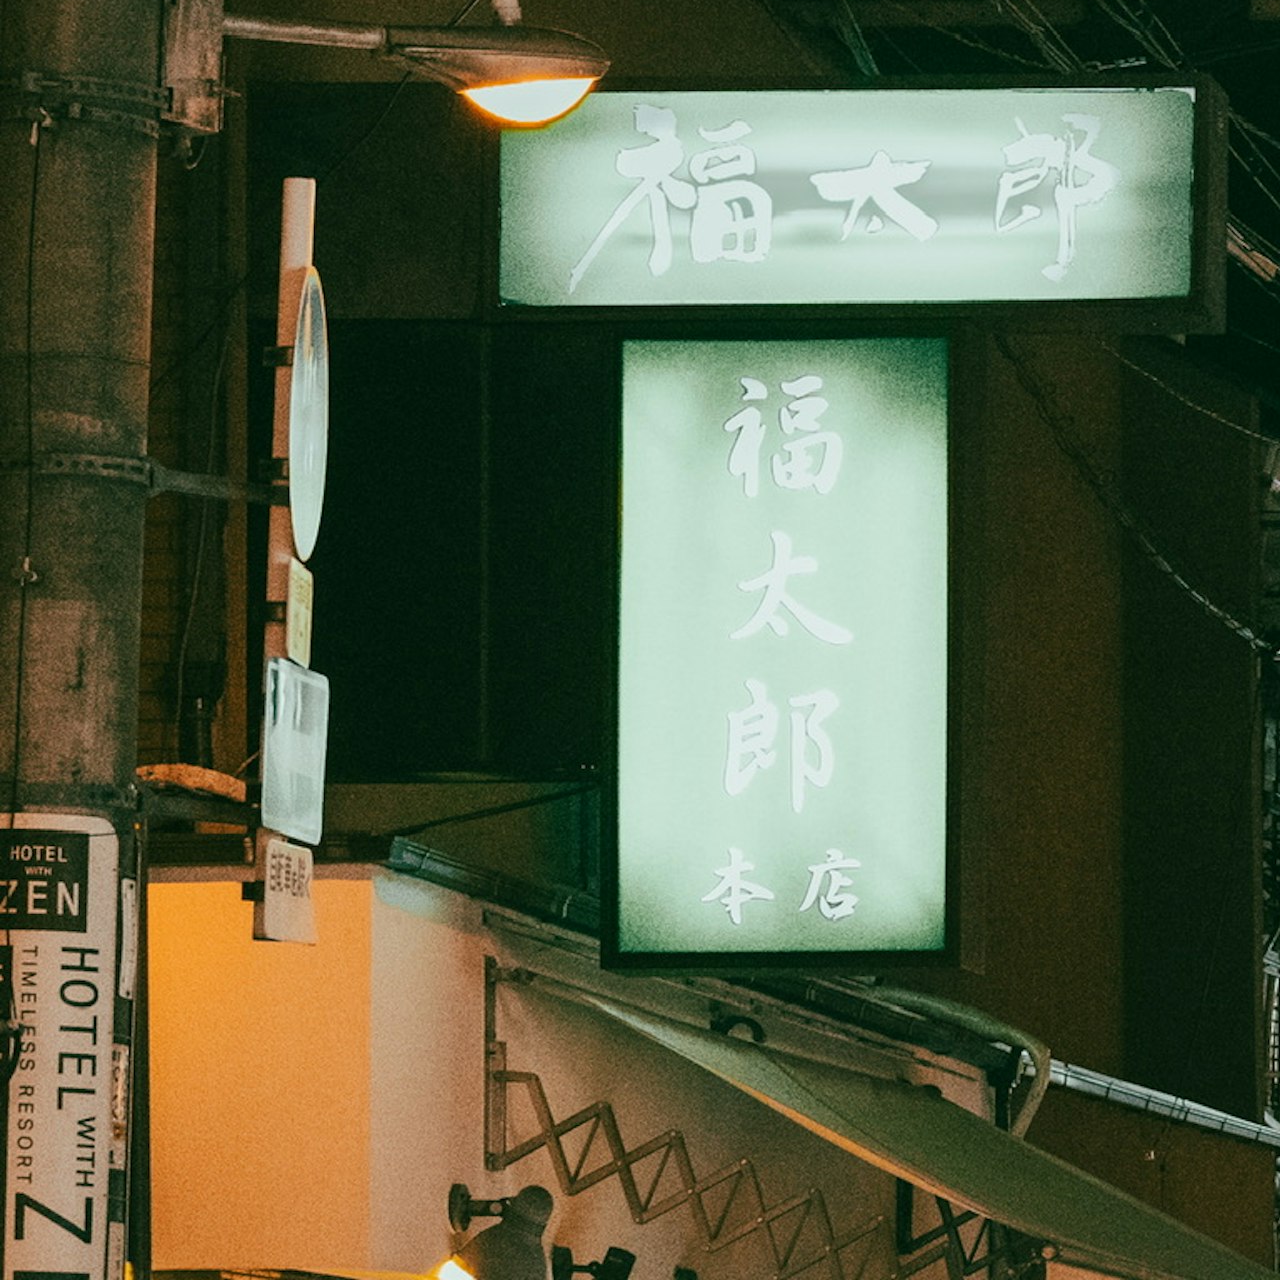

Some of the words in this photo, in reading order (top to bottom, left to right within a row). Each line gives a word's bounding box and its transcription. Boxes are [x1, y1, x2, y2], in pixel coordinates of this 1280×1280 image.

[569, 104, 1122, 295] 福太郎
[723, 374, 853, 813] 福太郎
[10, 845, 68, 863] HOTEL
[24, 866, 52, 877] WITH
[701, 848, 860, 925] 本店
[20, 946, 38, 1073] TIMELESS
[57, 946, 100, 1111] HOTEL
[16, 1086, 35, 1185] RESORT
[76, 1117, 97, 1188] WITH
